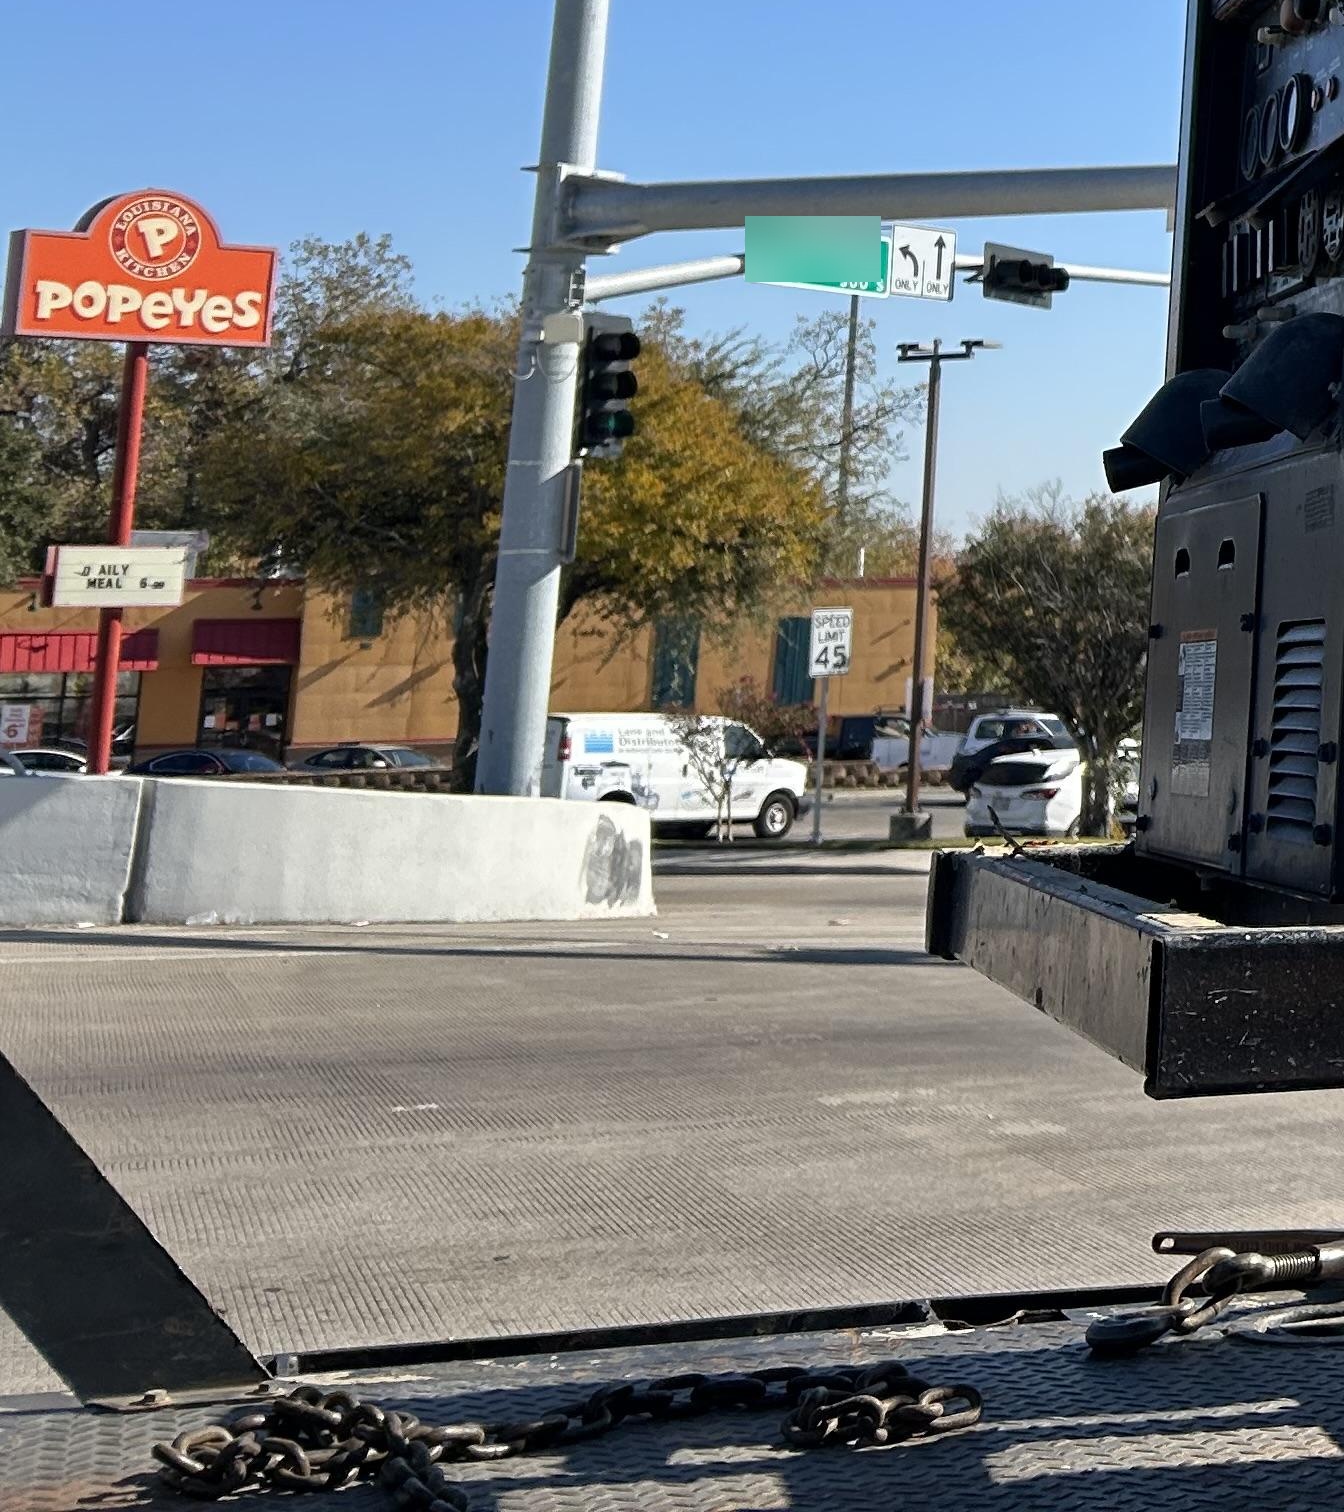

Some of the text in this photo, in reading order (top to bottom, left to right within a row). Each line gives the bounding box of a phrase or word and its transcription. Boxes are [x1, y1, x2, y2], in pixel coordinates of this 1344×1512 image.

[116, 200, 195, 237] LOUISIANA
[137, 216, 179, 258] P
[116, 247, 192, 279] KITCHEN
[895, 279, 918, 292] ONLY
[926, 281, 949, 294] ONLY
[86, 577, 122, 589] MEAL
[815, 614, 850, 628] SPEED
[818, 629, 846, 644] LIMIT
[815, 646, 847, 669] 45
